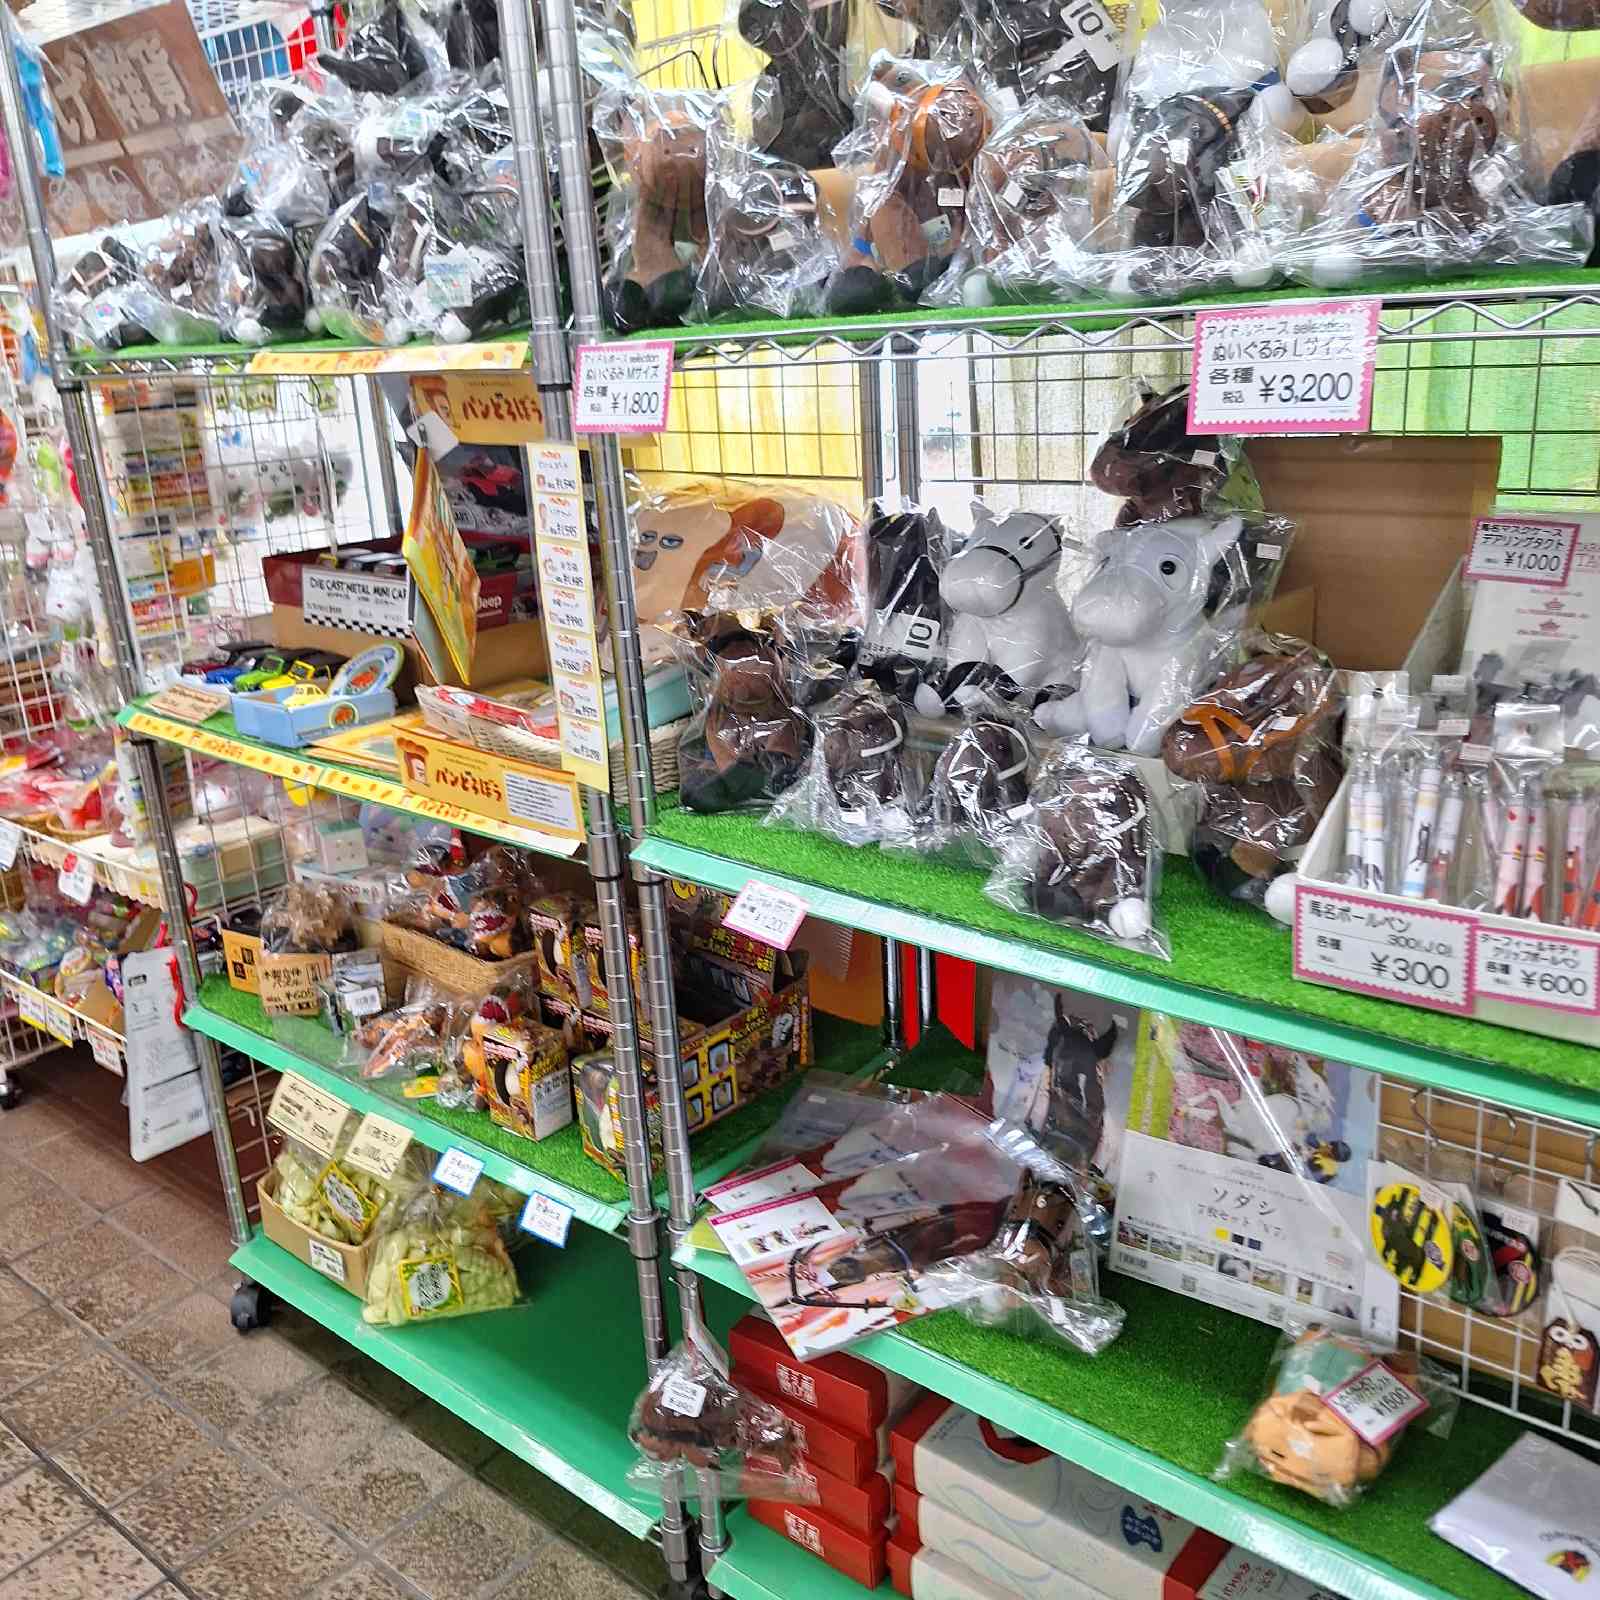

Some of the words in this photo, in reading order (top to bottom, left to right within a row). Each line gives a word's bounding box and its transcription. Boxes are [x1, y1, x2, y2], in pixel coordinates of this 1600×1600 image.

[1209, 366, 1254, 386] 各種
[1258, 371, 1354, 404] ¥3,200
[584, 385, 609, 398] 各種
[611, 391, 660, 416] ¥1,800
[1503, 550, 1561, 572] ¥1,000
[310, 576, 326, 591] DIE
[326, 579, 345, 593] CAST
[435, 768, 503, 802] パンどろぼう
[1310, 899, 1412, 933] 馬名ボールペン
[1316, 934, 1344, 951] 各種
[1368, 951, 1450, 989] ¥300
[1520, 969, 1588, 997] ¥600
[1213, 1187, 1276, 1216] ソダシ
